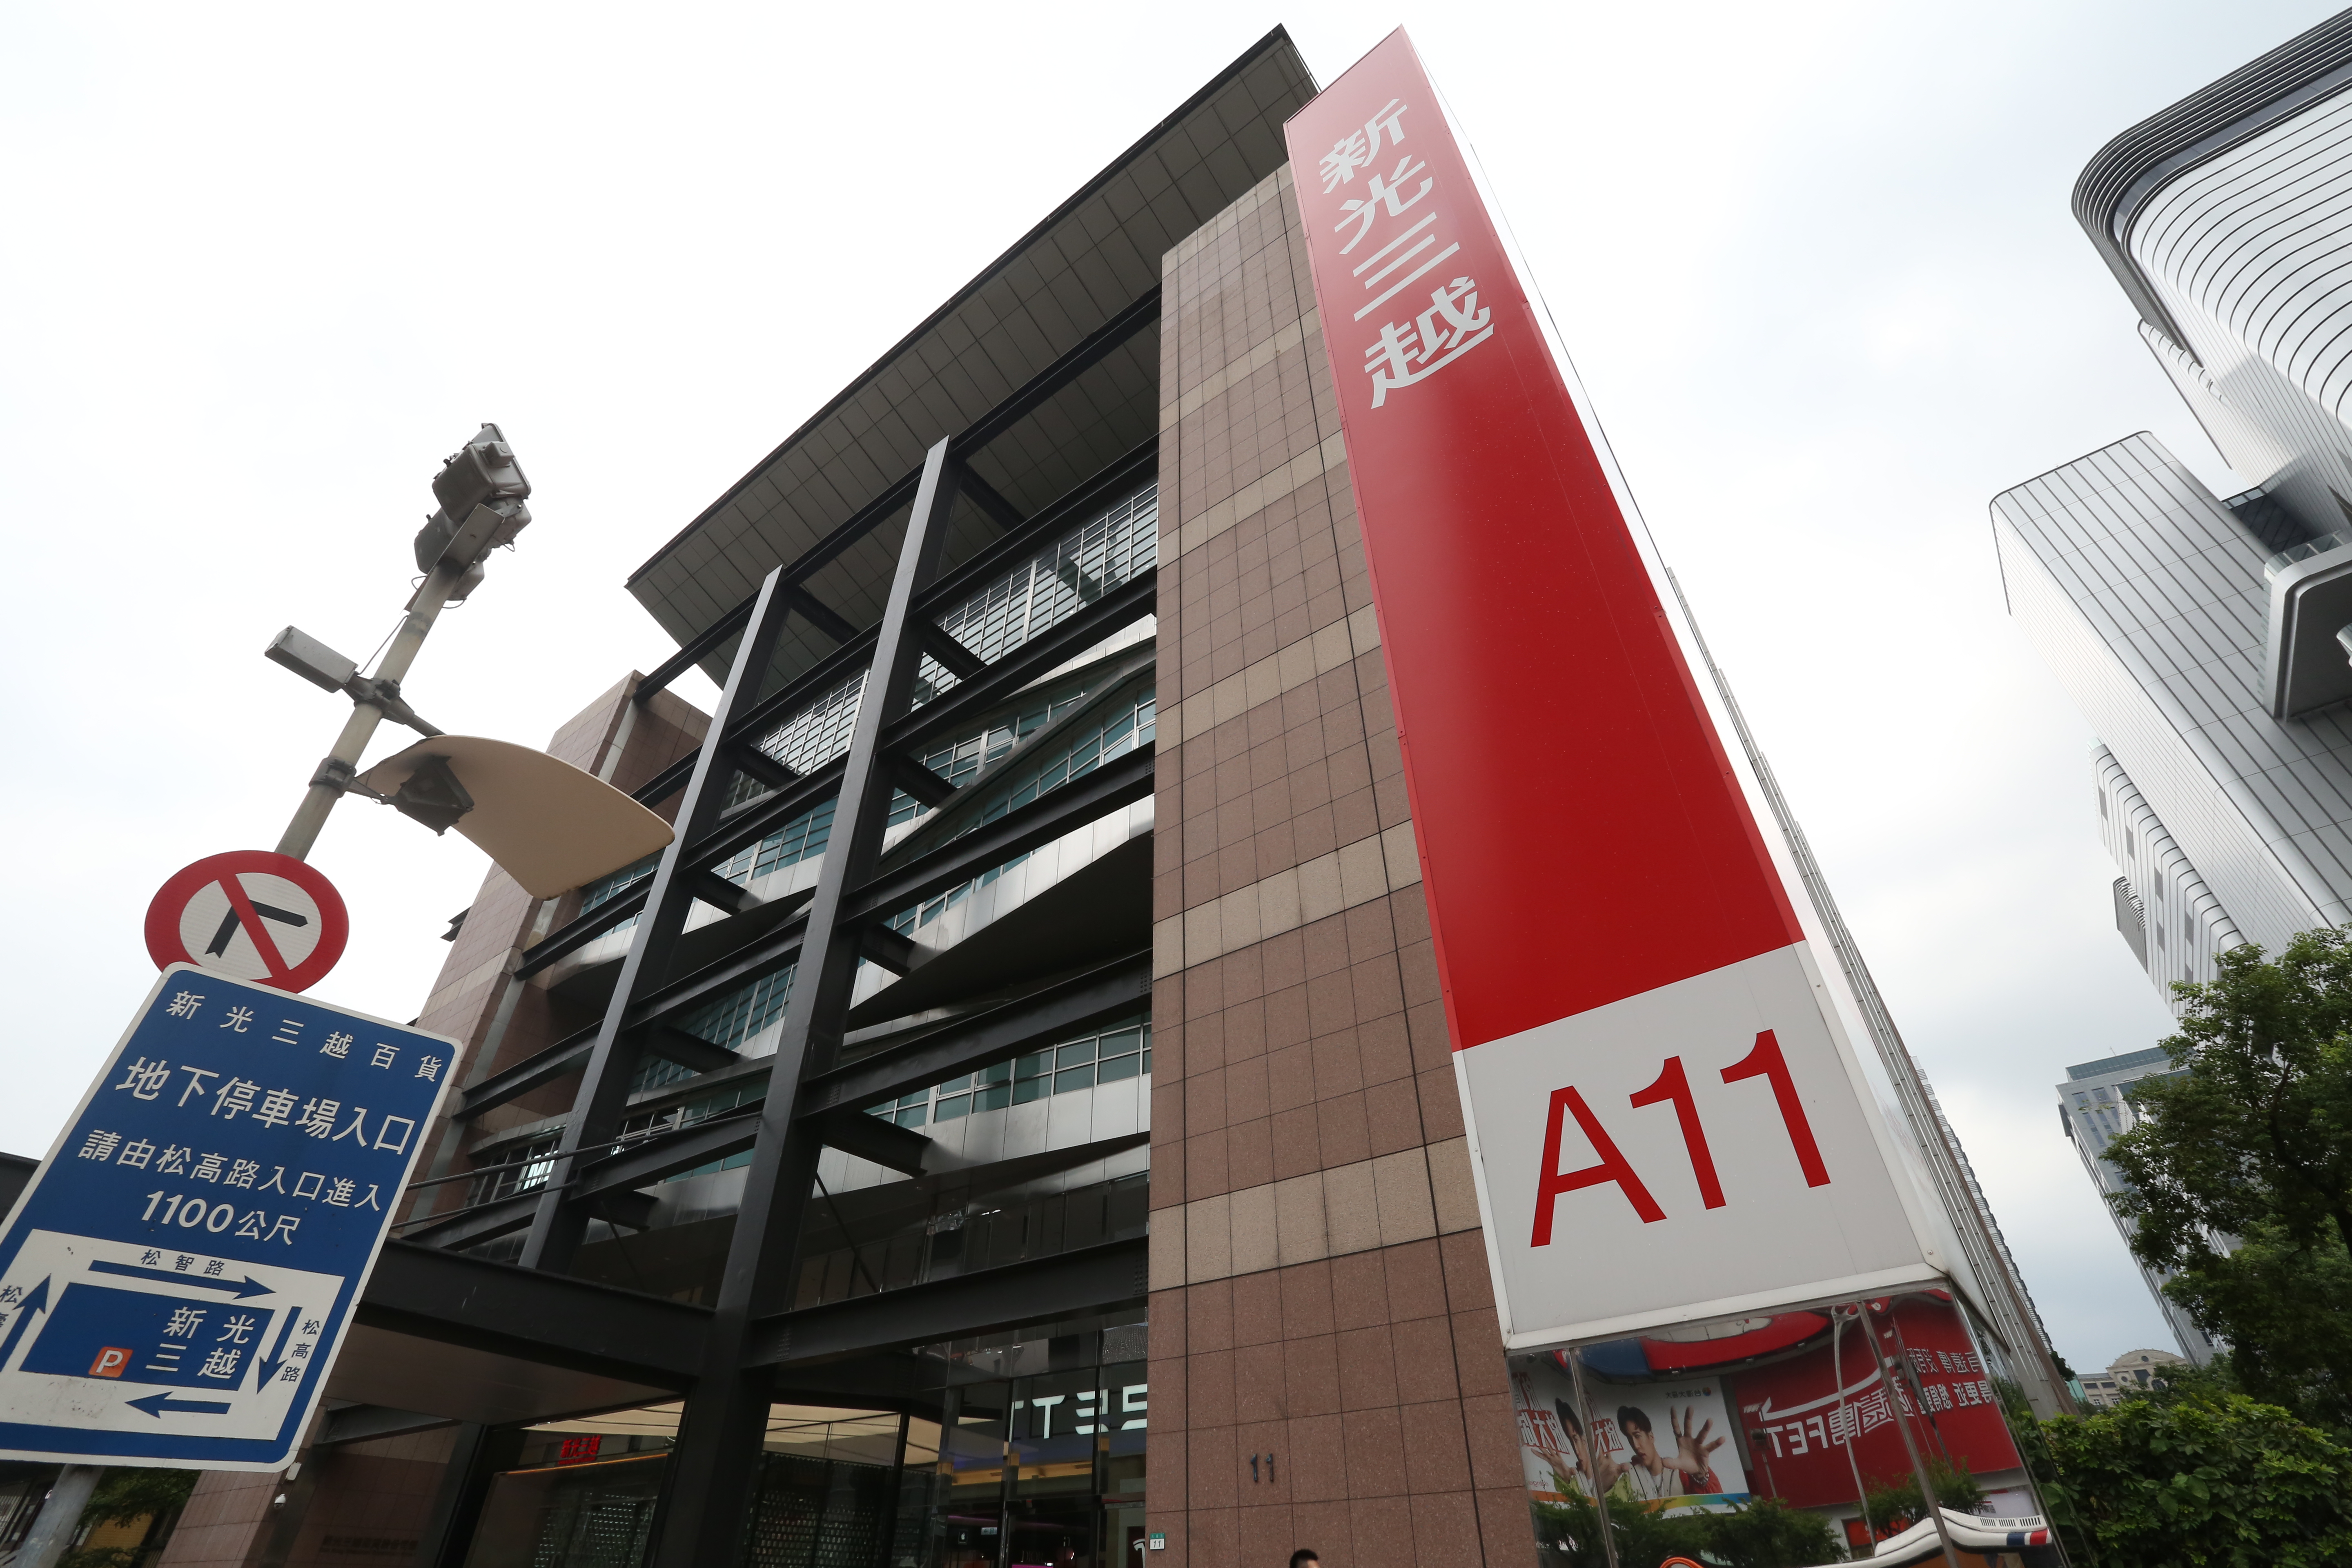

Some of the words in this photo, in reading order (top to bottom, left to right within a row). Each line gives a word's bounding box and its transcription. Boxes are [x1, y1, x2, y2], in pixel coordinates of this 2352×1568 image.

[1319, 98, 1495, 410] 新光三越
[166, 990, 443, 1082] 新光三越百貨
[115, 1056, 416, 1156] 地下停車場入口
[1530, 1029, 1831, 1248] A11
[78, 1128, 381, 1212] 請由松高路入口進入
[141, 1190, 301, 1246] 1100公尺
[140, 1249, 225, 1276] 松智路
[163, 1307, 256, 1345] 新光
[281, 1319, 321, 1383] 松高路
[96, 1350, 124, 1373] P
[145, 1343, 241, 1379] 三越
[1250, 1453, 1274, 1481] 11
[1153, 1539, 1161, 1548] 11
